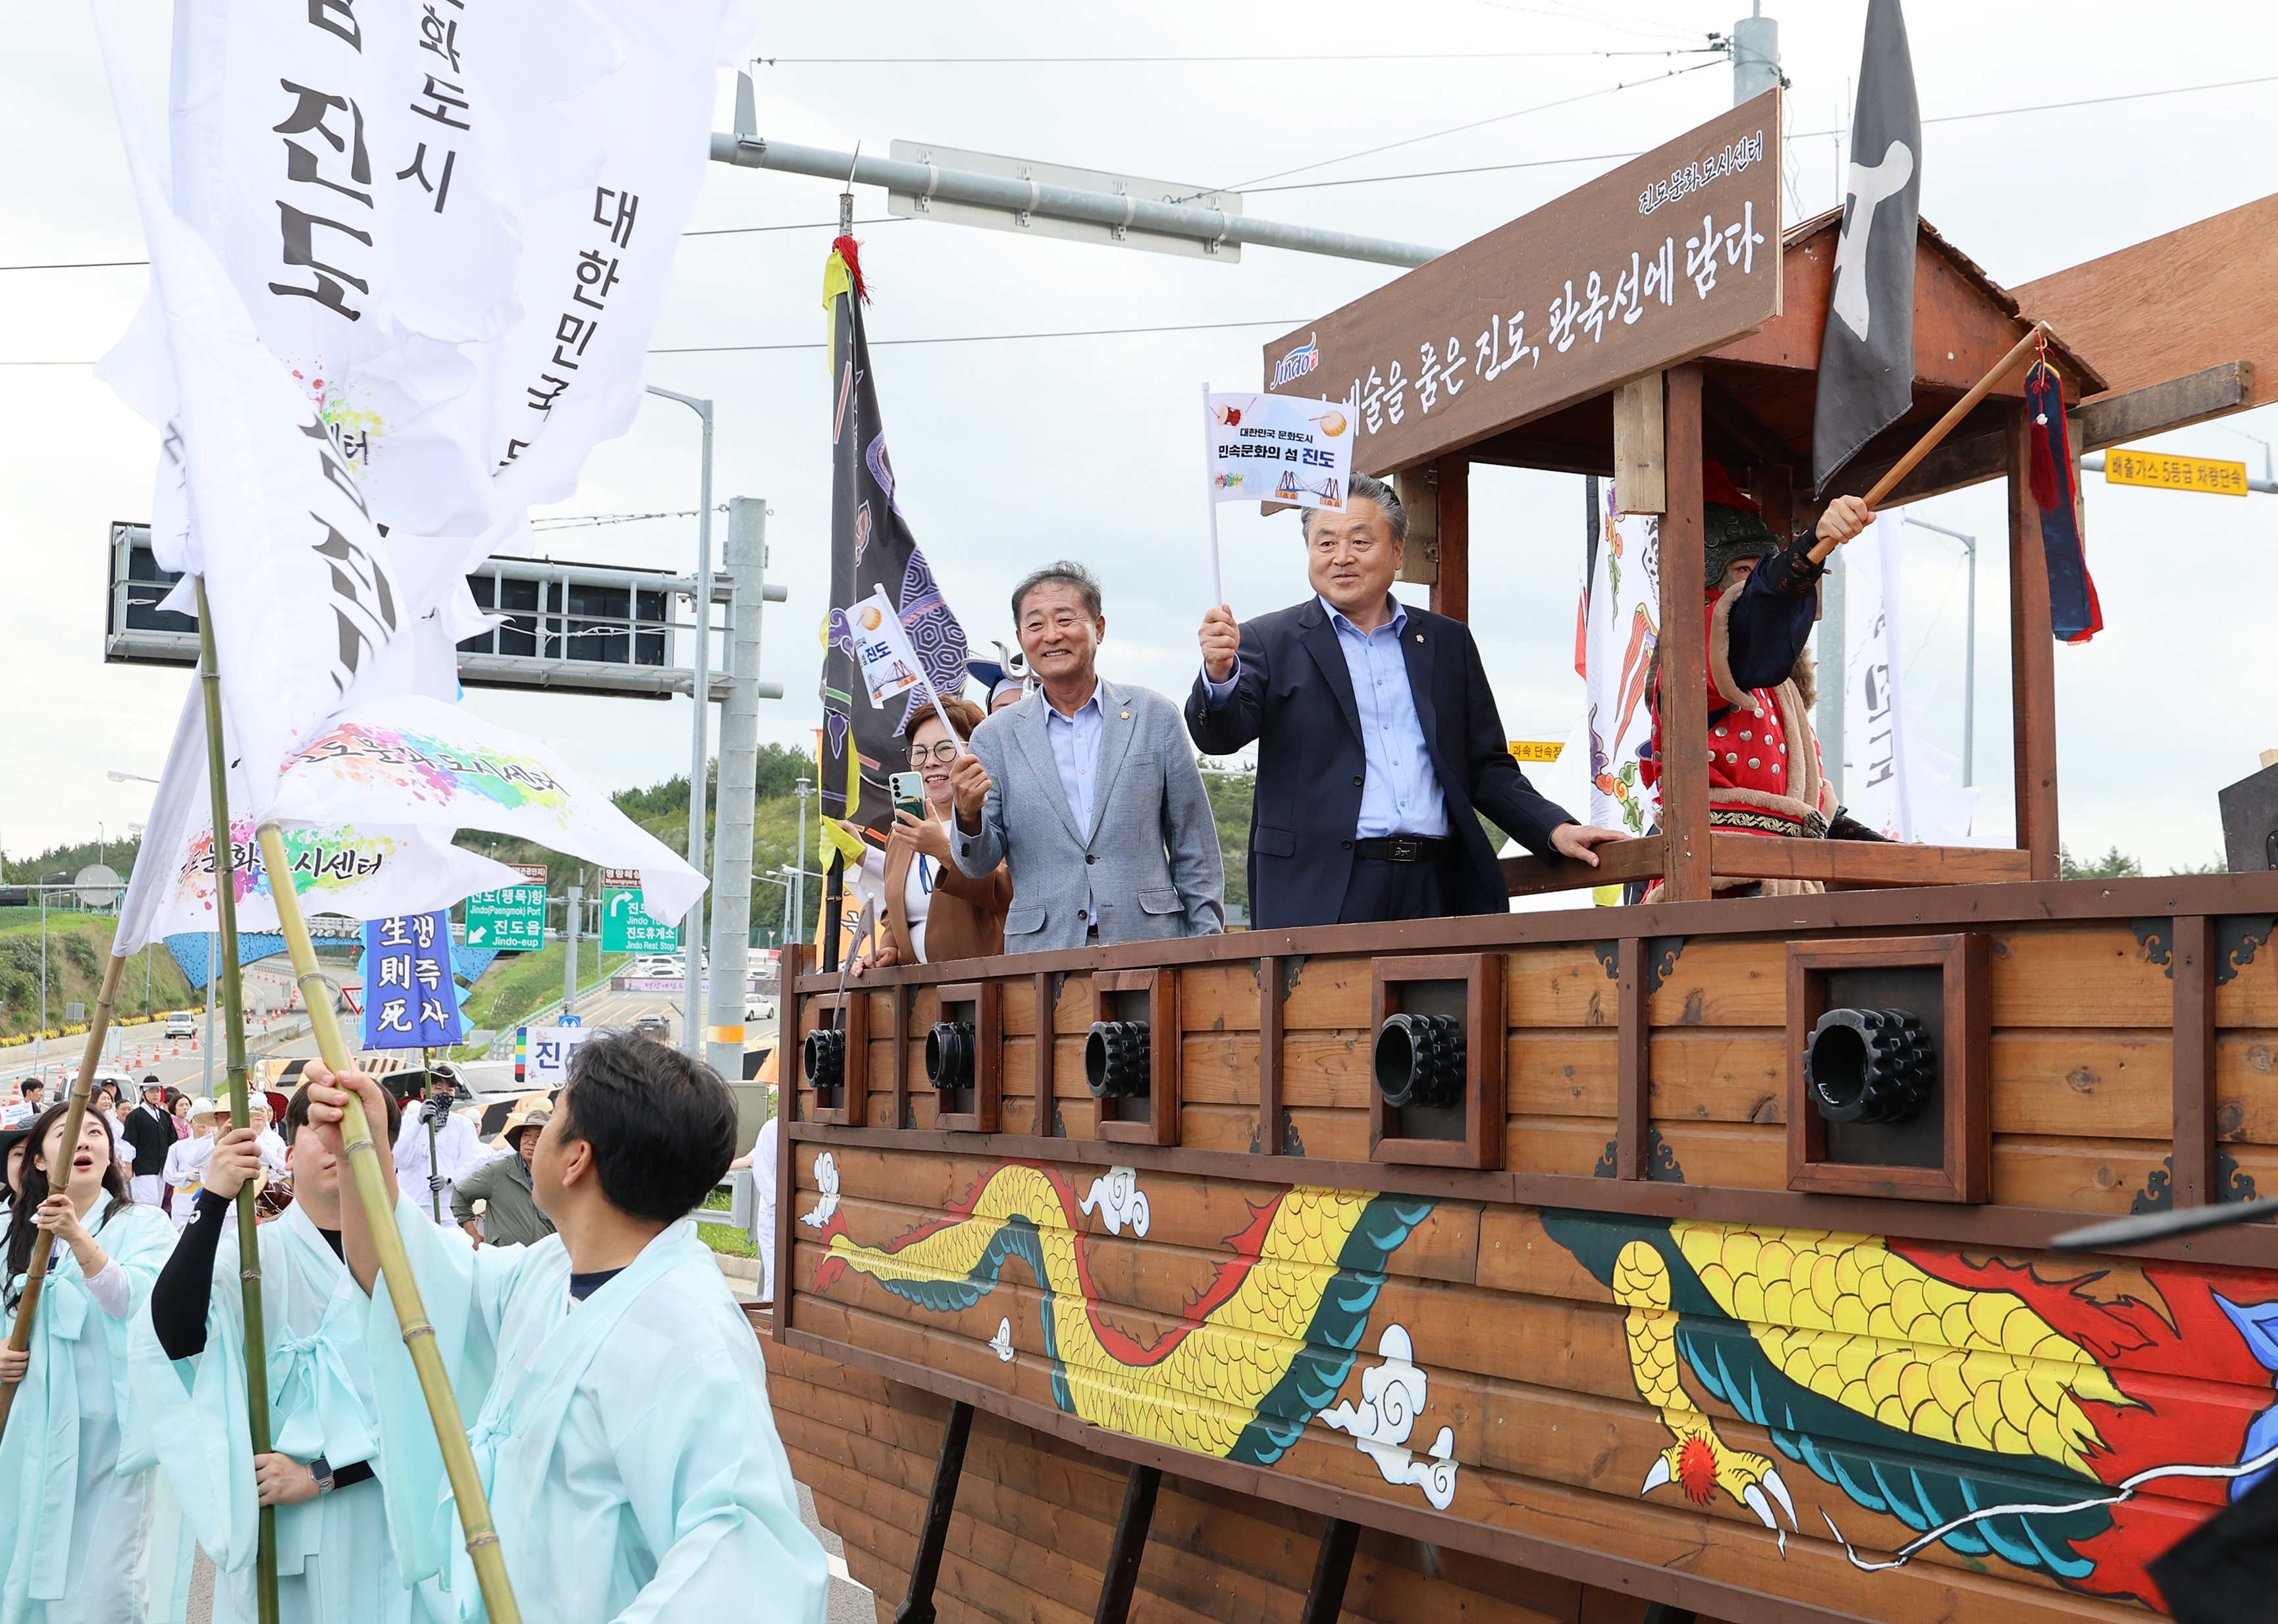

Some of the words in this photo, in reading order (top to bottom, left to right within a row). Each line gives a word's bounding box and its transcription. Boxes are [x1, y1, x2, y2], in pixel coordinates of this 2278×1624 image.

[396, 0, 471, 214] 화도시
[268, 78, 374, 322] 진도
[1415, 336, 1467, 414] 품은
[1475, 311, 1540, 381] 진도,
[1548, 237, 1674, 353] 판옥선에
[1685, 201, 1764, 300] 담다
[1269, 354, 1310, 390] Jindo
[1240, 427, 1275, 439] 대한민국
[1278, 430, 1313, 444] 문화도시
[1218, 444, 1281, 459] 민속문화의
[1285, 448, 1298, 461] 섬
[1302, 448, 1335, 469] 진도
[2112, 455, 2159, 480] 배출가스
[2162, 461, 2192, 485] 5등급
[2197, 465, 2242, 489] 차량단속
[865, 641, 892, 664] 진도
[1512, 745, 1531, 758] 과속
[469, 905, 526, 918] Jindo(Paengmok)
[527, 906, 542, 916] Port
[626, 916, 649, 925] Jindo
[493, 920, 542, 936] 진도읍
[626, 926, 675, 940] 진도휴게소
[492, 936, 539, 949] Jindo-eup
[625, 941, 643, 950] Jindo
[643, 941, 658, 950] Rest
[660, 941, 675, 952] Stop
[377, 916, 413, 1032] 生則死
[413, 915, 449, 1030] 생즉사
